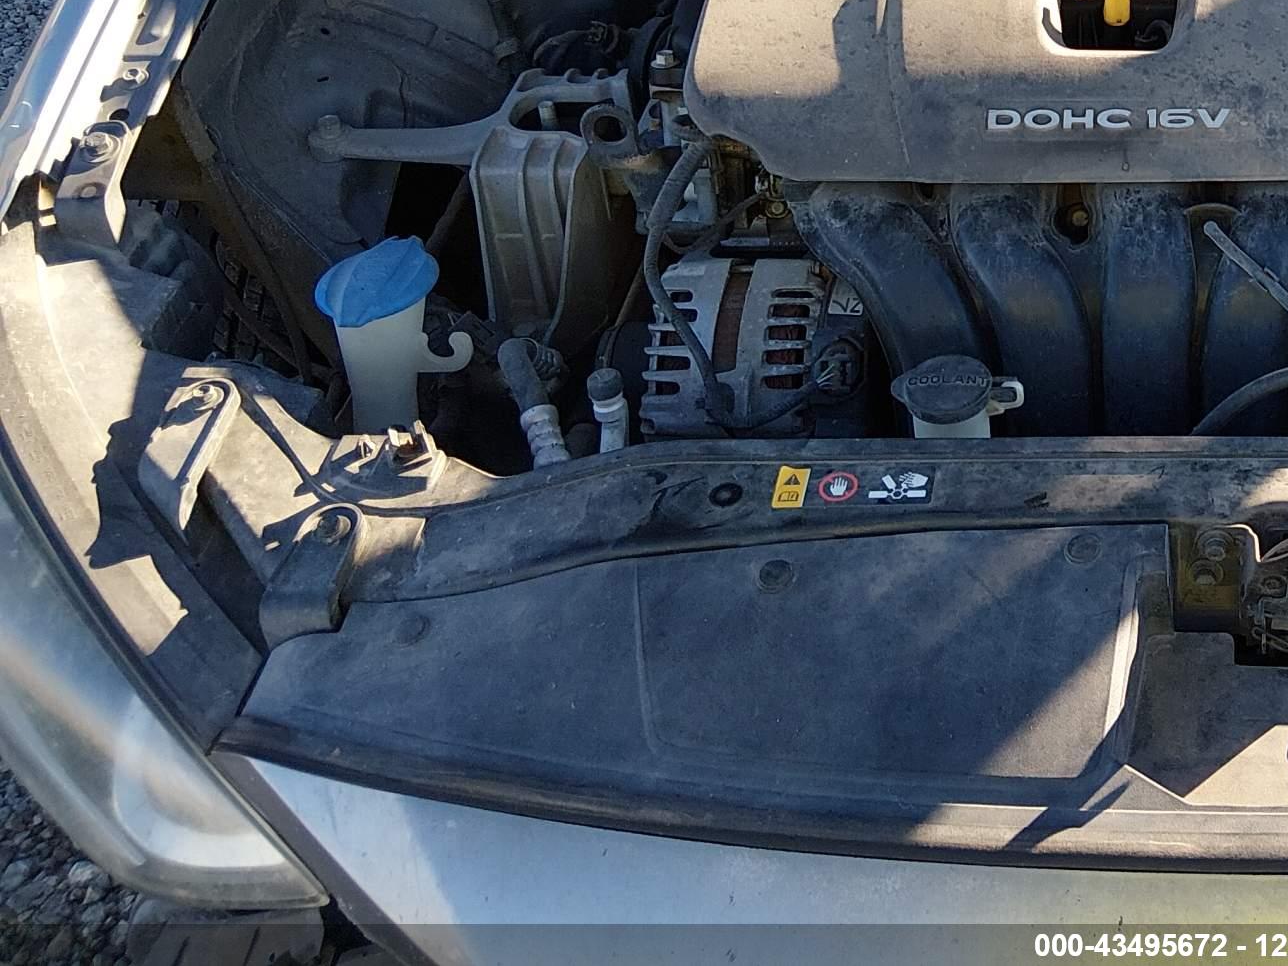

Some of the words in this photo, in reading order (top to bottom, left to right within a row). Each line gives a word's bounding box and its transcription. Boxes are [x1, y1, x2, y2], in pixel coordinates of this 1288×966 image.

[986, 108, 1131, 130] DOHC
[1147, 108, 1230, 129] 16V
[907, 374, 988, 387] COOLANT
